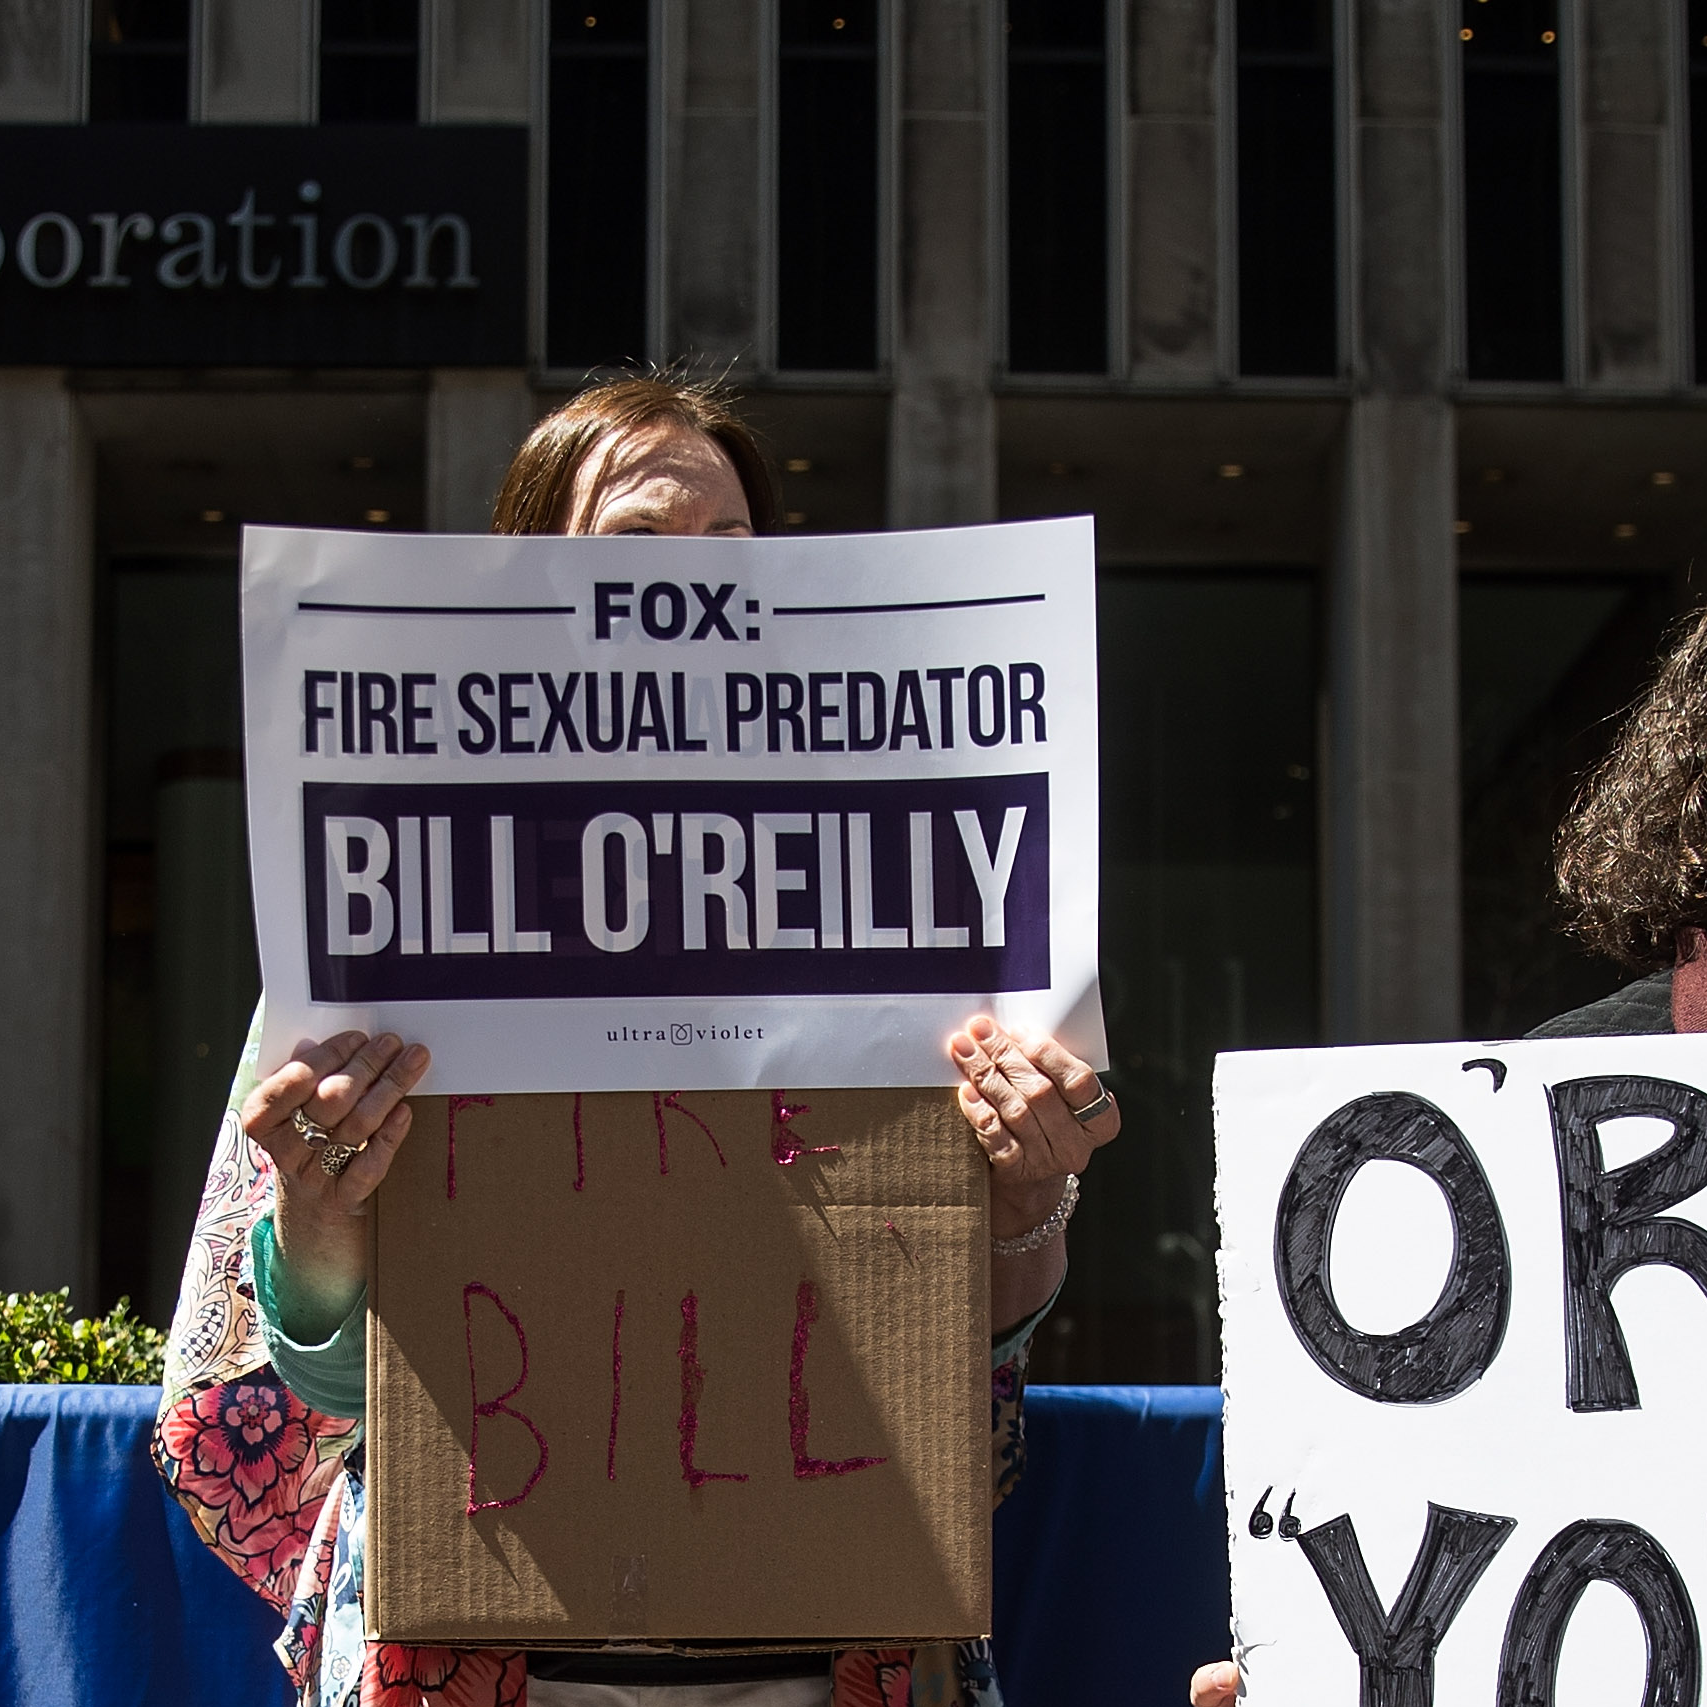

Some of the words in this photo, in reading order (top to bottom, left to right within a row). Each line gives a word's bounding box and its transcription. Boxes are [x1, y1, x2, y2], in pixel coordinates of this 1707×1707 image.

[594, 581, 762, 642] FOX:
[305, 670, 437, 754] FIRE
[457, 671, 708, 755] SEXUAL
[725, 662, 1048, 753] PREDATOR
[325, 814, 551, 956] BILL
[581, 806, 1028, 953] O'REILLY
[607, 1026, 666, 1041] ultra
[696, 1025, 764, 1040] violet
[463, 1281, 888, 1516] BILL
